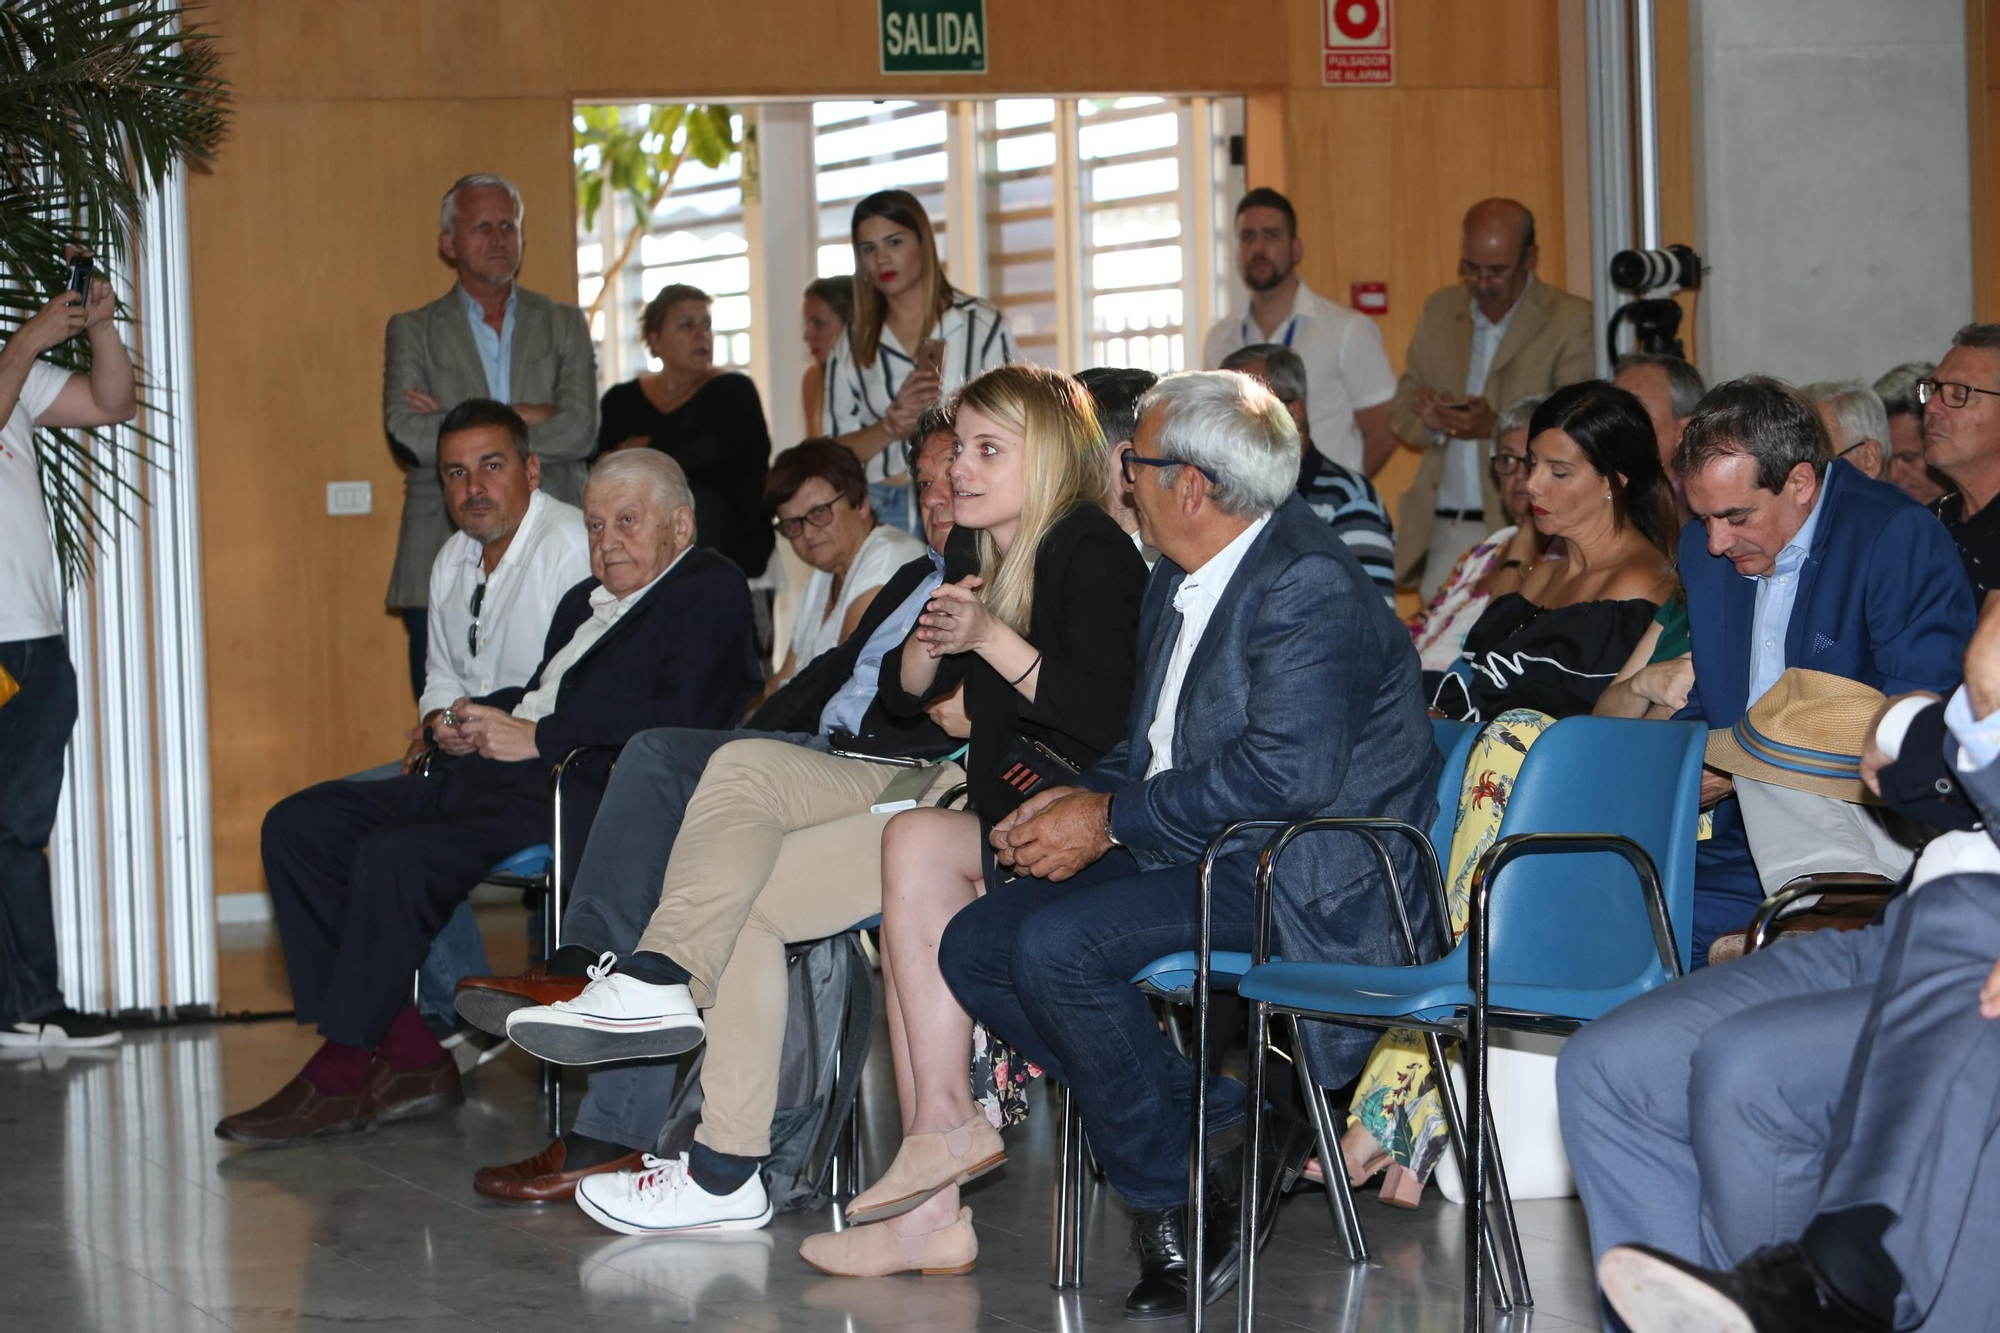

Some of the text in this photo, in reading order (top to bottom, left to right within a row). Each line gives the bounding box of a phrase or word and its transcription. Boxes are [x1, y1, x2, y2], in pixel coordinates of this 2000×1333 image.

[886, 12, 981, 55] SALIDA
[1328, 55, 1388, 67] PULSADOR
[1326, 69, 1389, 80] DE ALARMA
